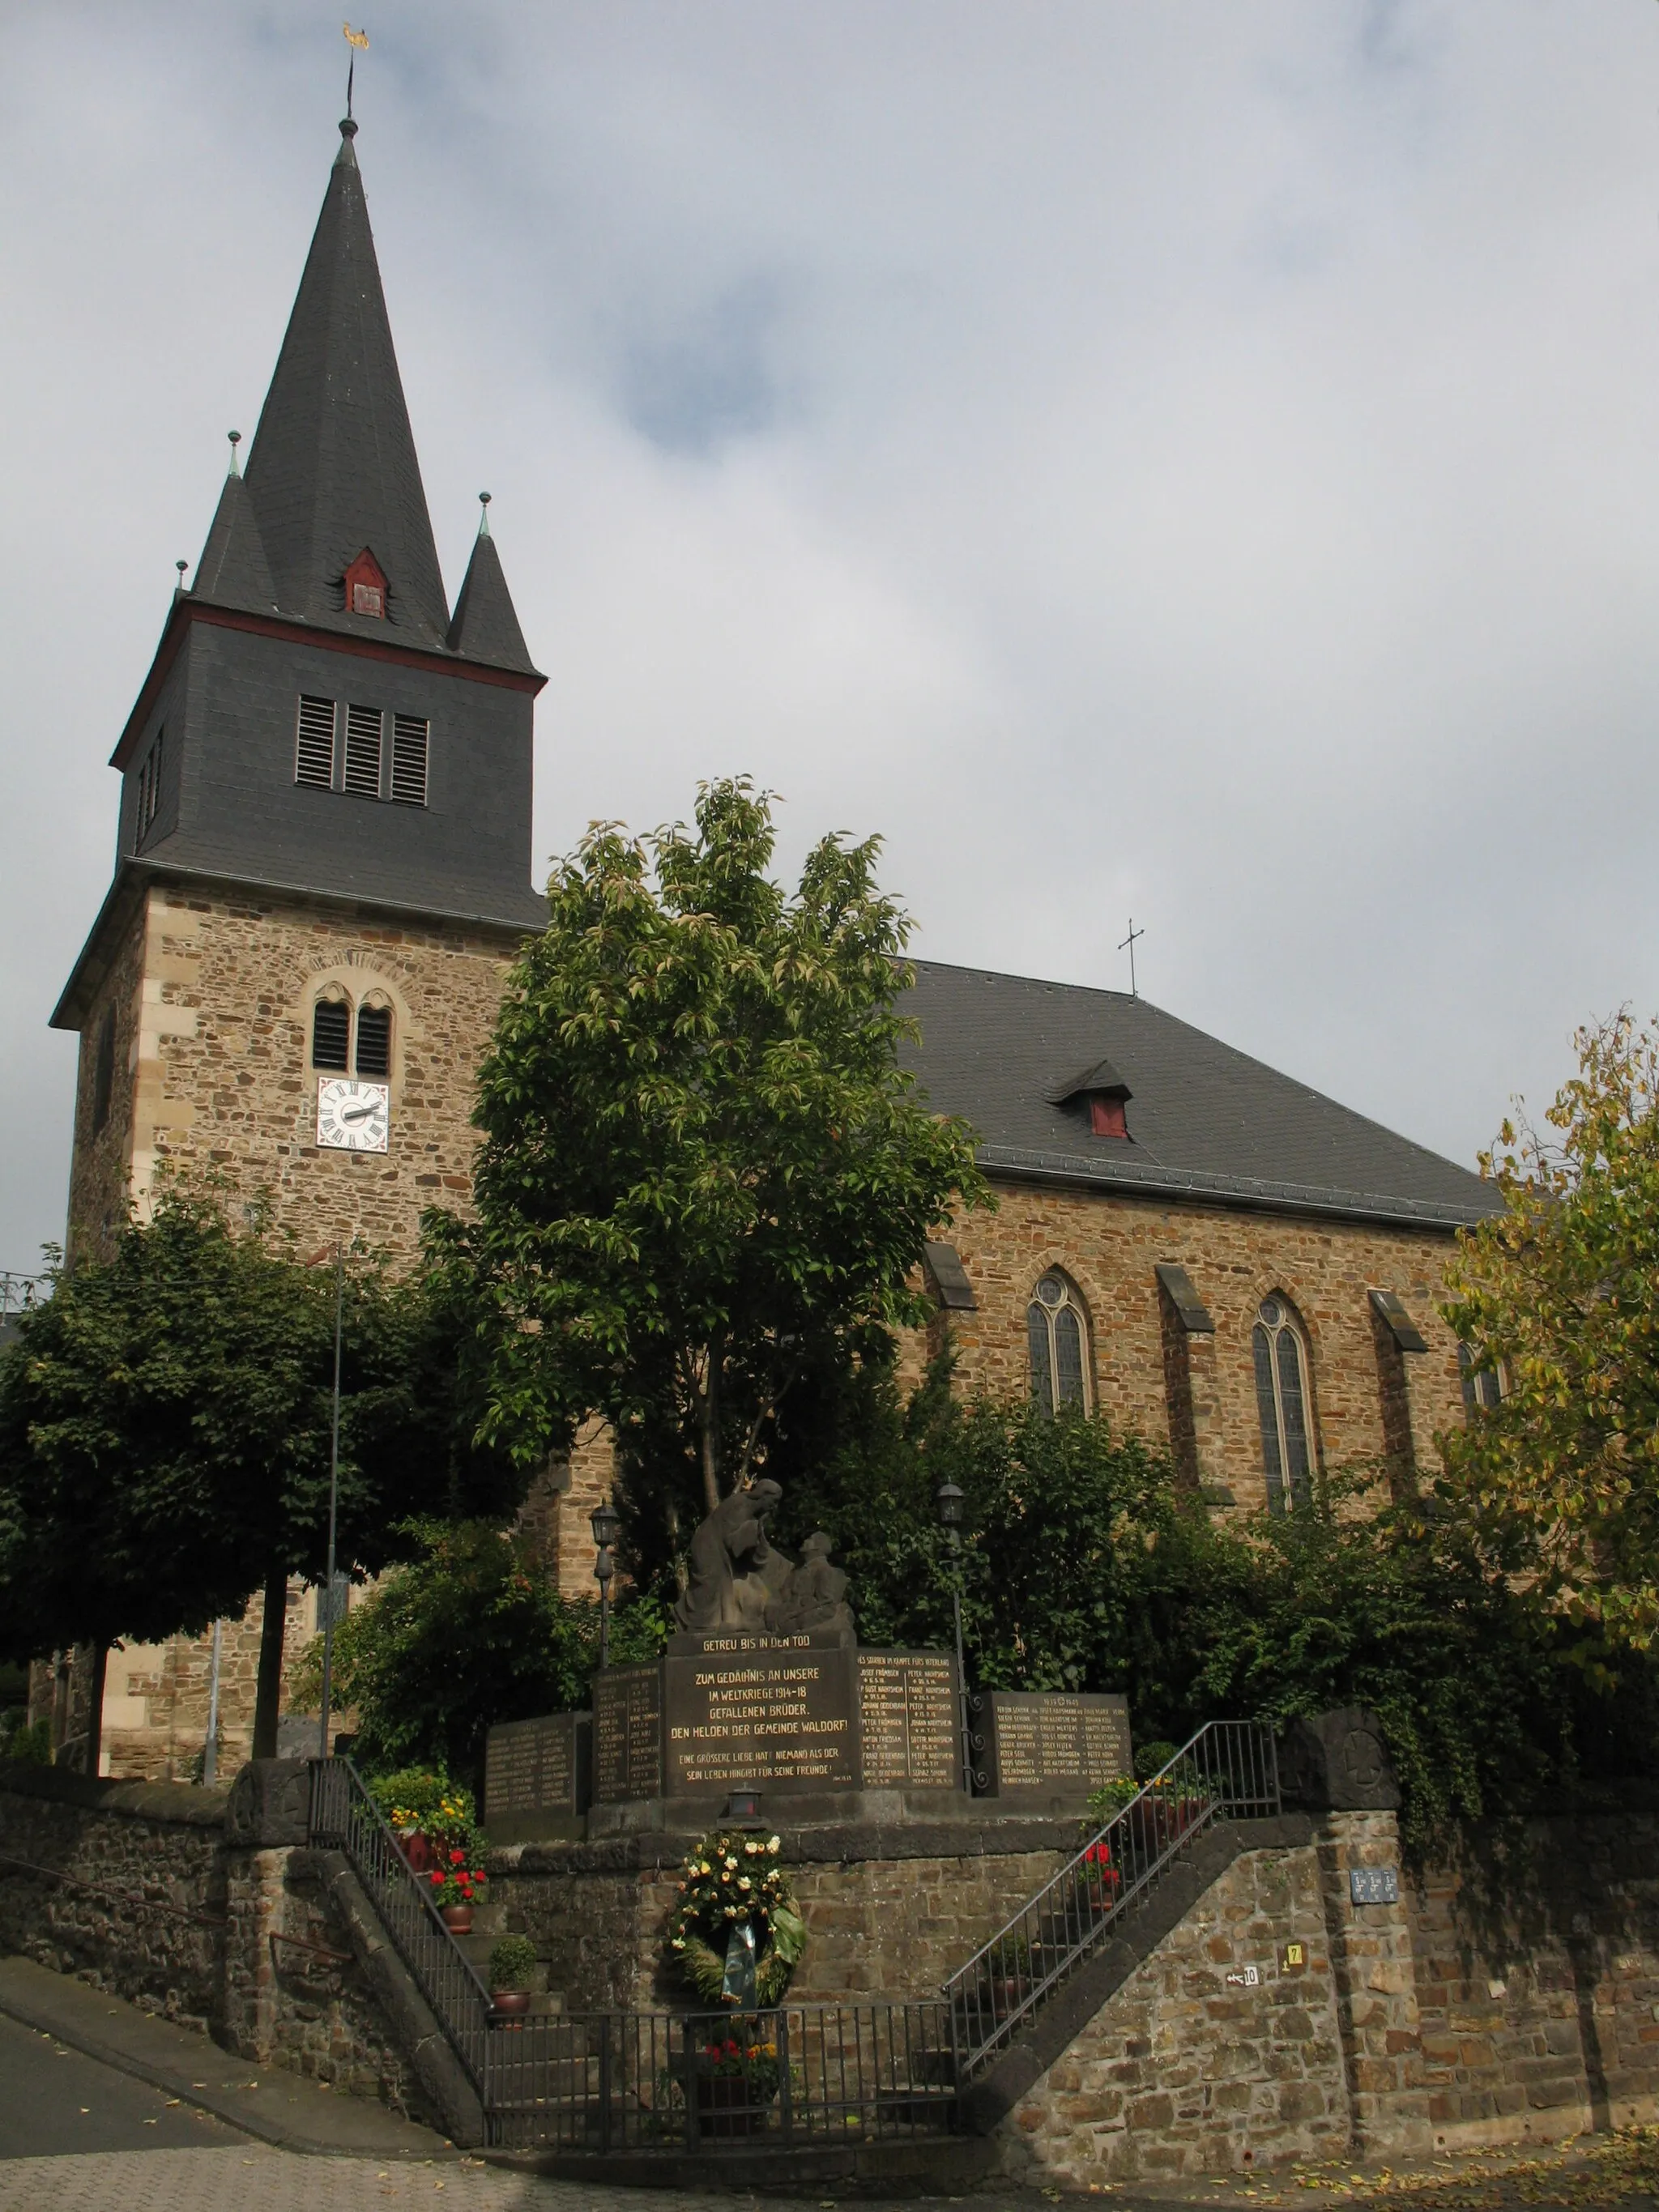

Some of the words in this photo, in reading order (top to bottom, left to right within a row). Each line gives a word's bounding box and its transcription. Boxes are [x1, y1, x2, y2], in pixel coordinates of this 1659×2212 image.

[703, 1639, 737, 1652] GETREU
[740, 1638, 756, 1650] BIS
[759, 1637, 768, 1648] IN
[793, 1634, 810, 1647] TOD
[695, 1673, 715, 1686] ZUM
[767, 1669, 781, 1681] AN
[783, 1667, 820, 1680] UNSERE
[709, 1690, 720, 1703] IM
[721, 1687, 774, 1701] WELTKRIEGE
[775, 1686, 807, 1698] 1914-18
[710, 1706, 766, 1720] GEFALLENEN
[769, 1703, 811, 1717] BRÜDER.
[671, 1727, 690, 1739] DEN
[693, 1725, 728, 1738] HELDEN
[731, 1724, 750, 1736] DER
[753, 1722, 799, 1735] GEMEINDE
[800, 1720, 848, 1733] WALDORF!
[679, 1754, 695, 1764] EINE
[697, 1752, 731, 1763] GRÖSSERE
[732, 1752, 753, 1762] LIEBE
[755, 1751, 769, 1762] HAT
[774, 1750, 808, 1760] NIEMAND
[809, 1749, 822, 1758] ALS
[824, 1748, 839, 1758] DER
[686, 1770, 702, 1781] SEIN
[704, 1769, 727, 1780] LEBEN
[729, 1768, 757, 1779] HINGIBT
[758, 1766, 773, 1777] FÜR
[774, 1766, 795, 1776] SEINE
[796, 1764, 833, 1775] FREUNDE!
[1291, 1948, 1298, 1962] 7
[1245, 1969, 1256, 1983] 10
